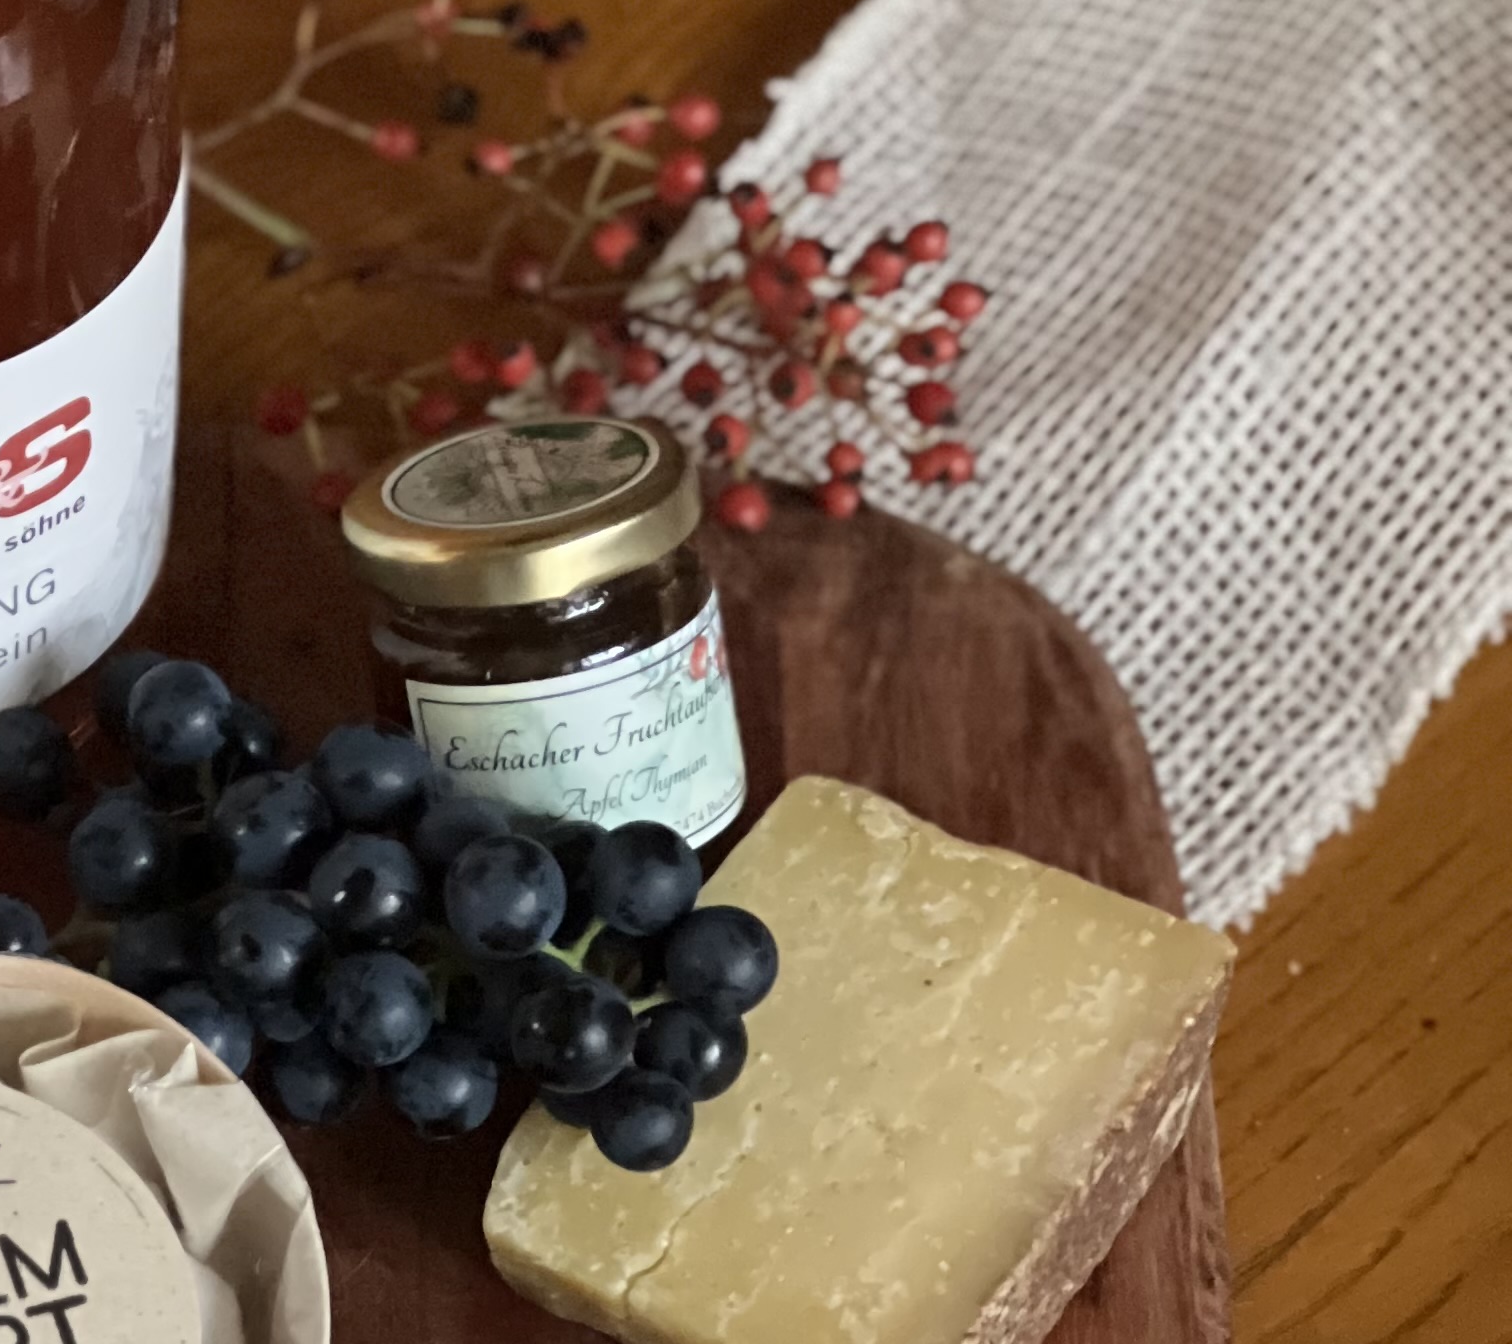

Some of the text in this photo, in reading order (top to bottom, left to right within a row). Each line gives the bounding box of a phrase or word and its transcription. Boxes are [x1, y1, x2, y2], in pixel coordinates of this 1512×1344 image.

[5, 494, 86, 553] söhne
[445, 722, 585, 771] Eschacher
[546, 769, 633, 822] Apfel
